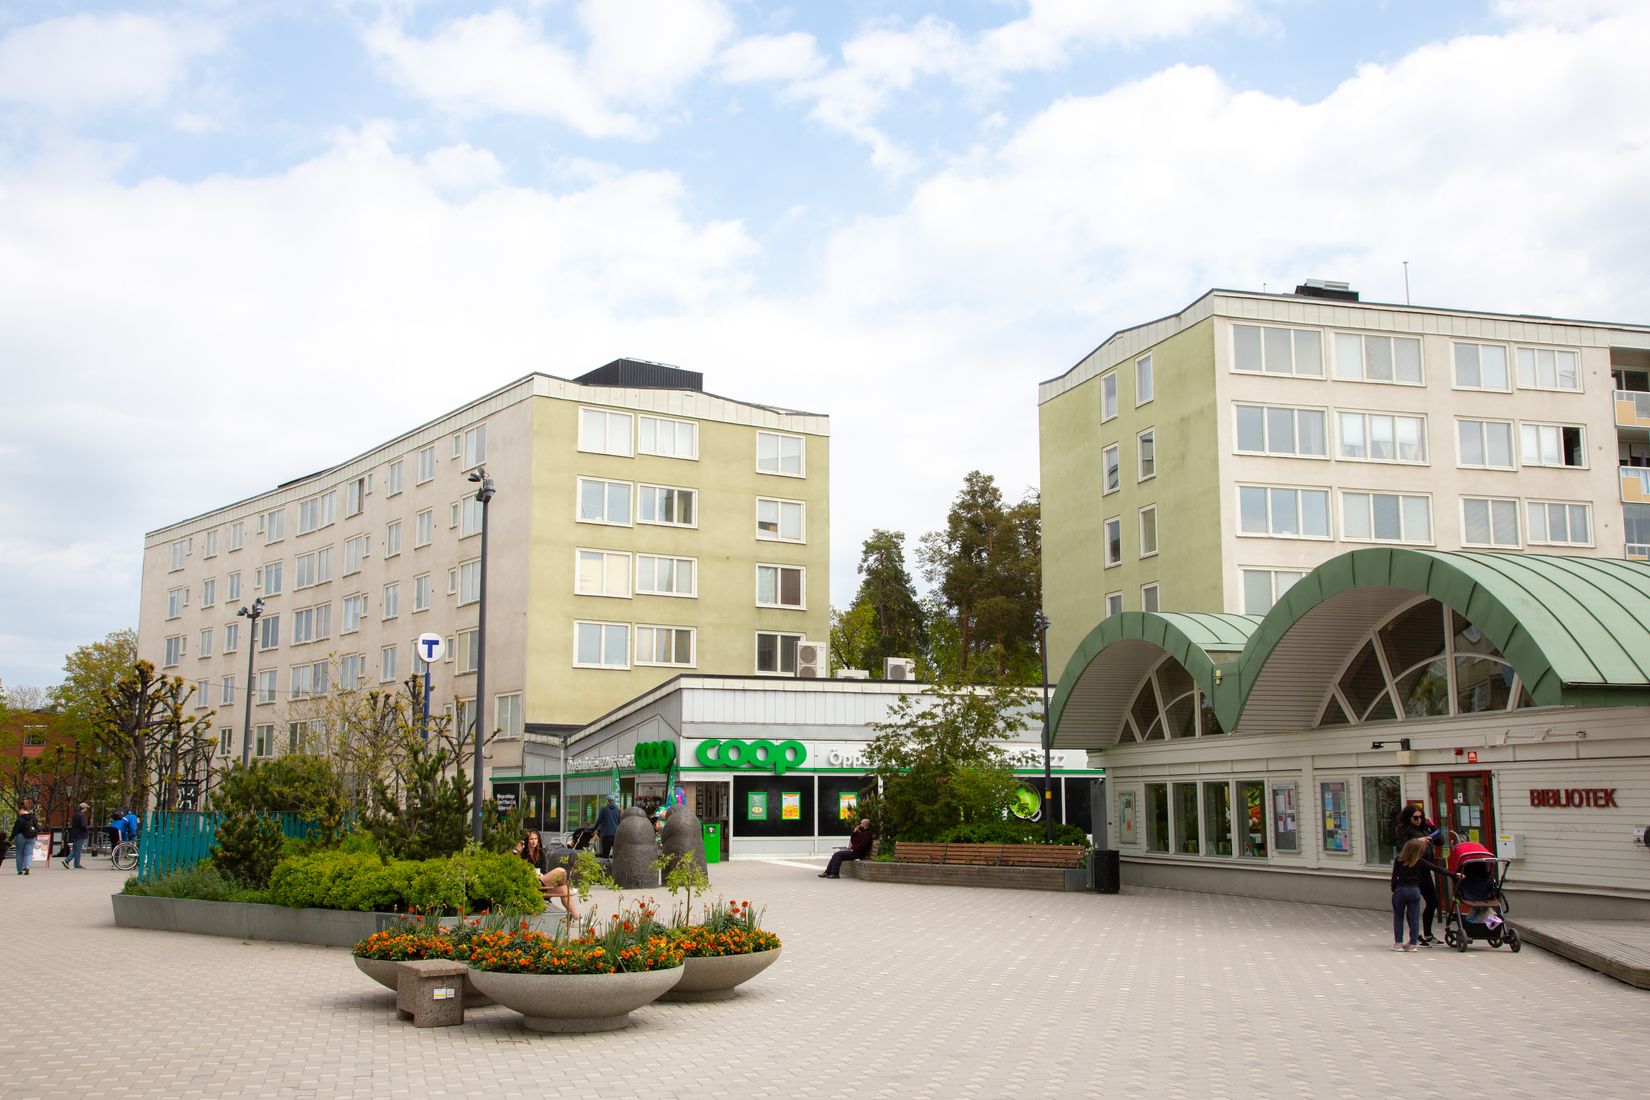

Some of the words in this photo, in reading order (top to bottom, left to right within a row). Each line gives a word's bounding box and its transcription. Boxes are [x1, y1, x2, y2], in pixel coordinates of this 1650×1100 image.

[422, 639, 440, 659] T
[695, 738, 807, 775] coop
[1529, 788, 1619, 808] BIBLIOTEK
